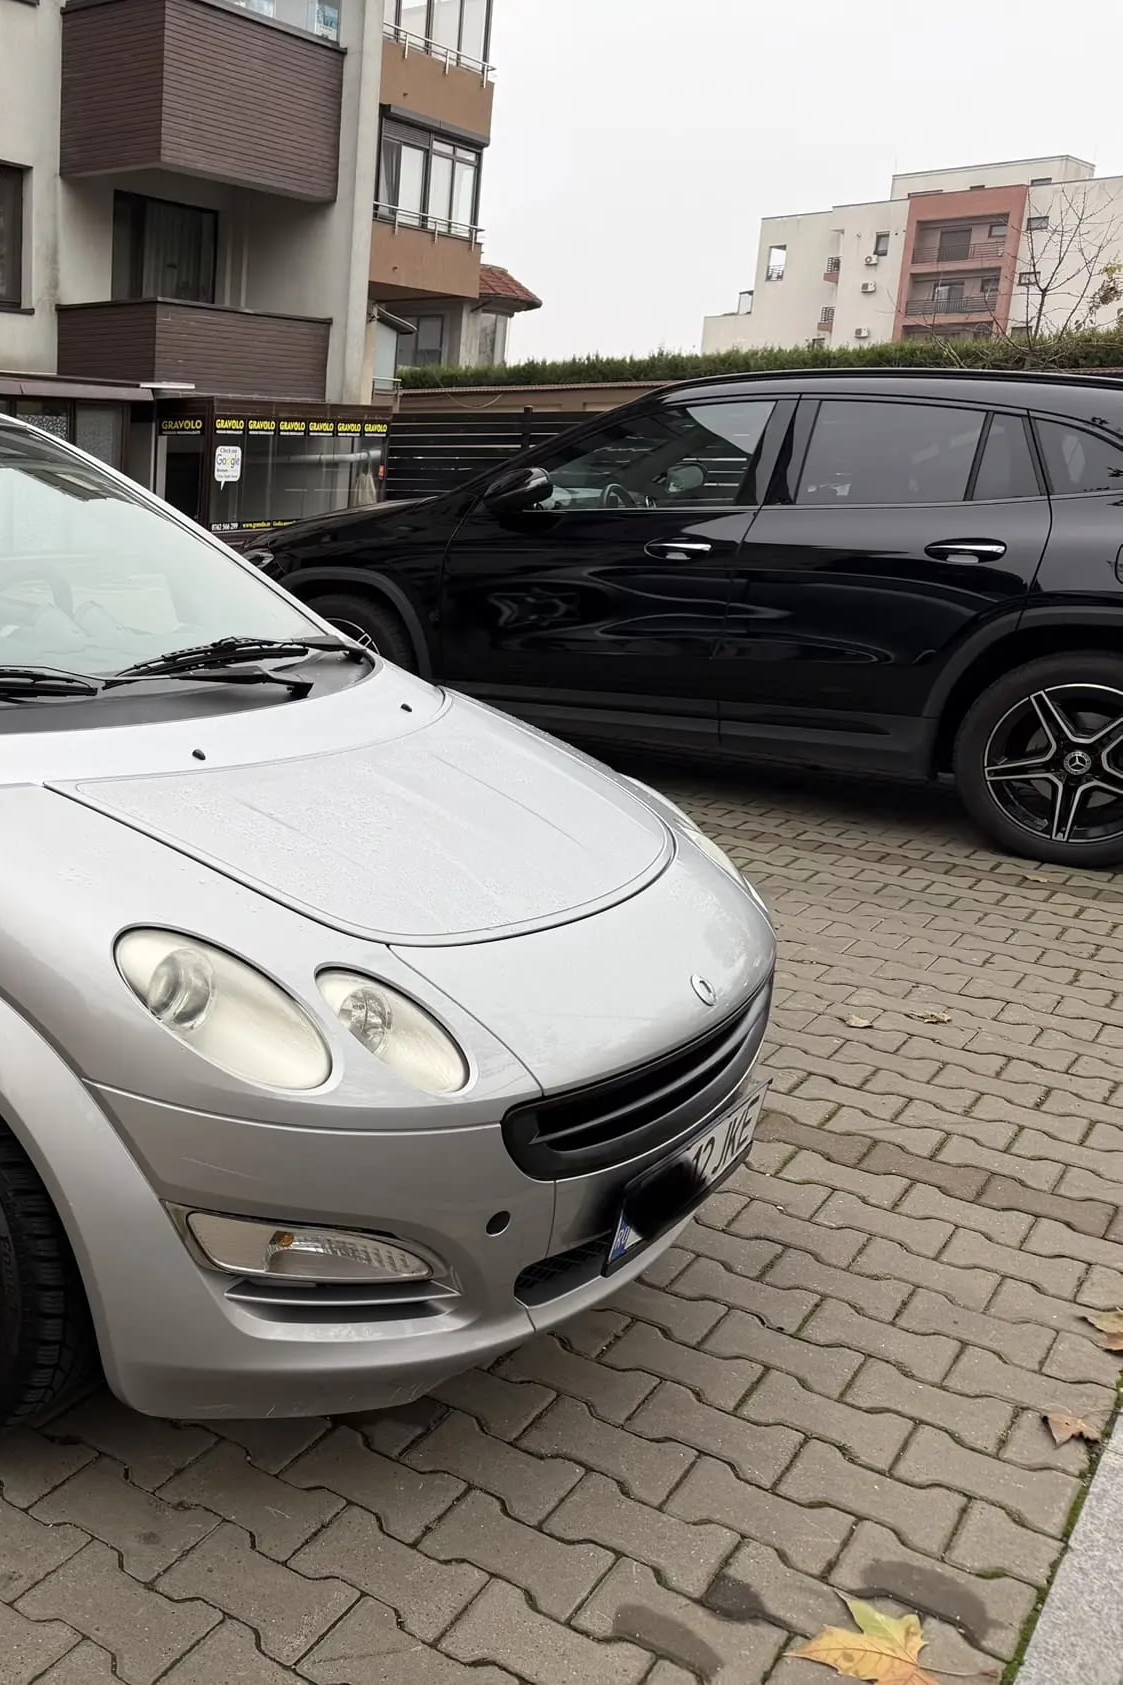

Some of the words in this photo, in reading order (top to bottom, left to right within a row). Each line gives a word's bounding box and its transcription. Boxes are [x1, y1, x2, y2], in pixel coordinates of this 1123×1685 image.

[161, 419, 203, 430] GRAVOLO
[216, 419, 245, 430] GRAVOLO
[248, 420, 276, 430] GRAVOLO
[279, 421, 306, 431] GRAVOLO
[309, 422, 334, 431] GRAVOLO
[337, 423, 362, 432] GRAVOLO
[364, 424, 388, 433] GRAVOLO
[216, 453, 240, 469] Google
[711, 1094, 761, 1175] JKE
